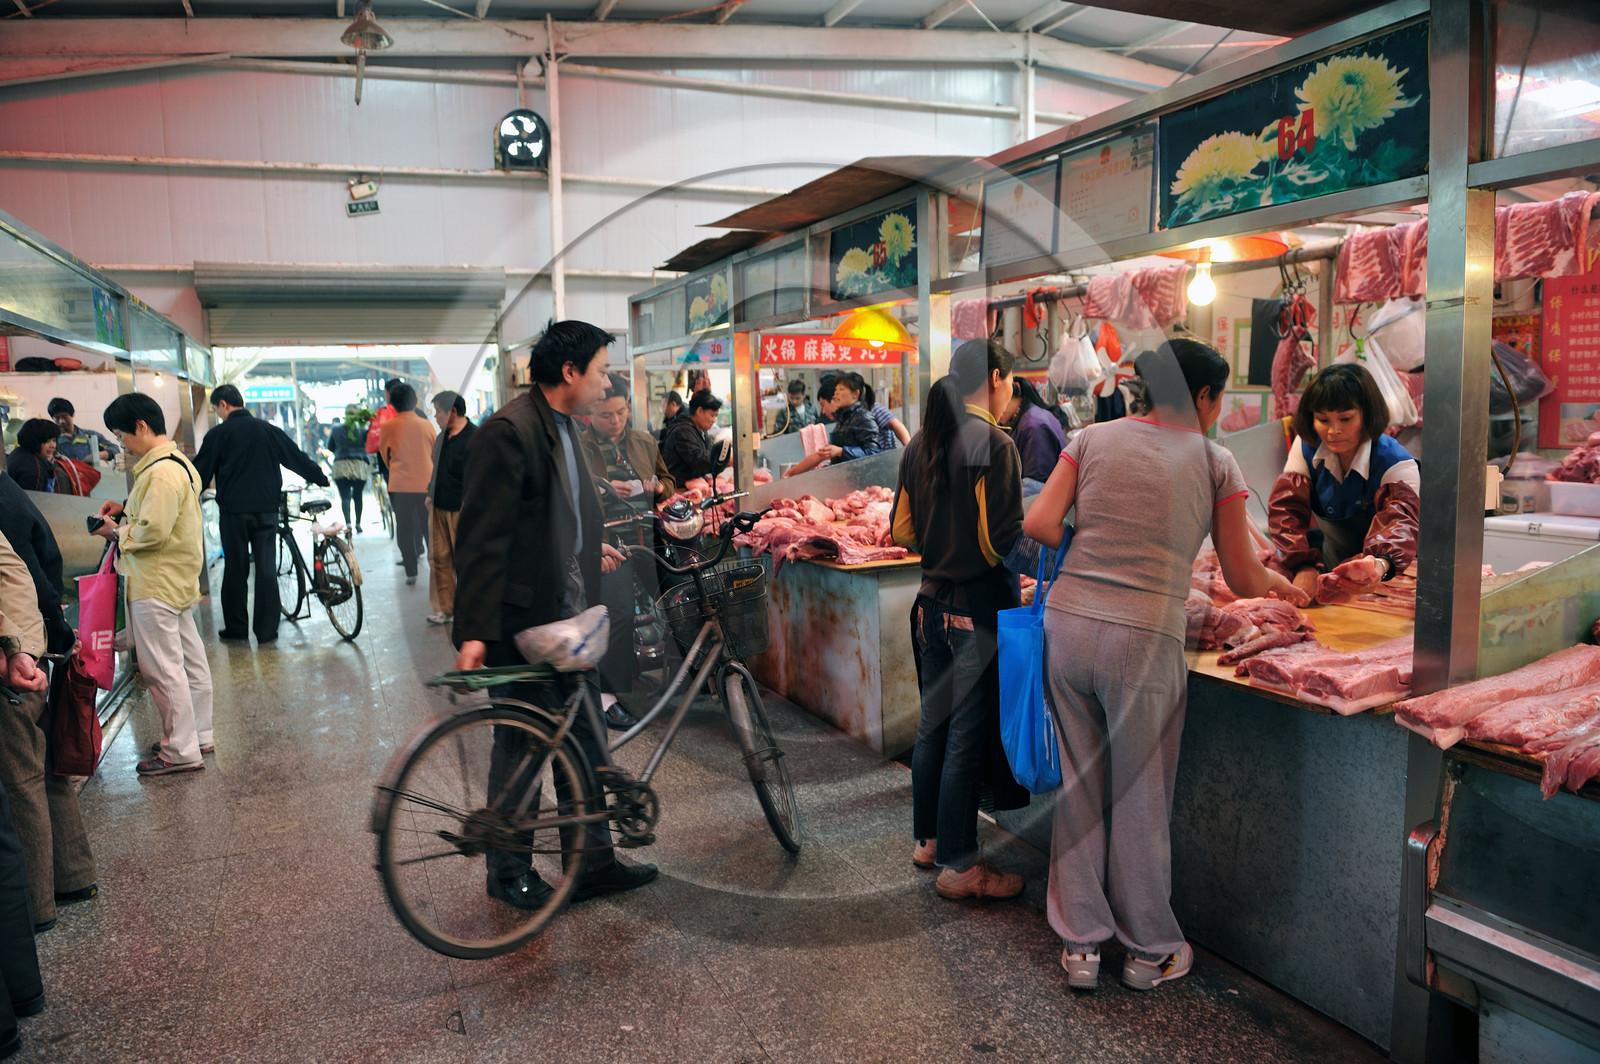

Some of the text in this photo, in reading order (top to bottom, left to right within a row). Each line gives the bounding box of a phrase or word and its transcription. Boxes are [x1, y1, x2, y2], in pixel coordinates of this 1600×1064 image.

[1277, 107, 1316, 160] 64
[873, 240, 887, 268] 65
[1571, 284, 1600, 296] 什么是
[710, 343, 722, 354] 30
[764, 338, 796, 361] 火锅
[91, 629, 113, 651] 12
